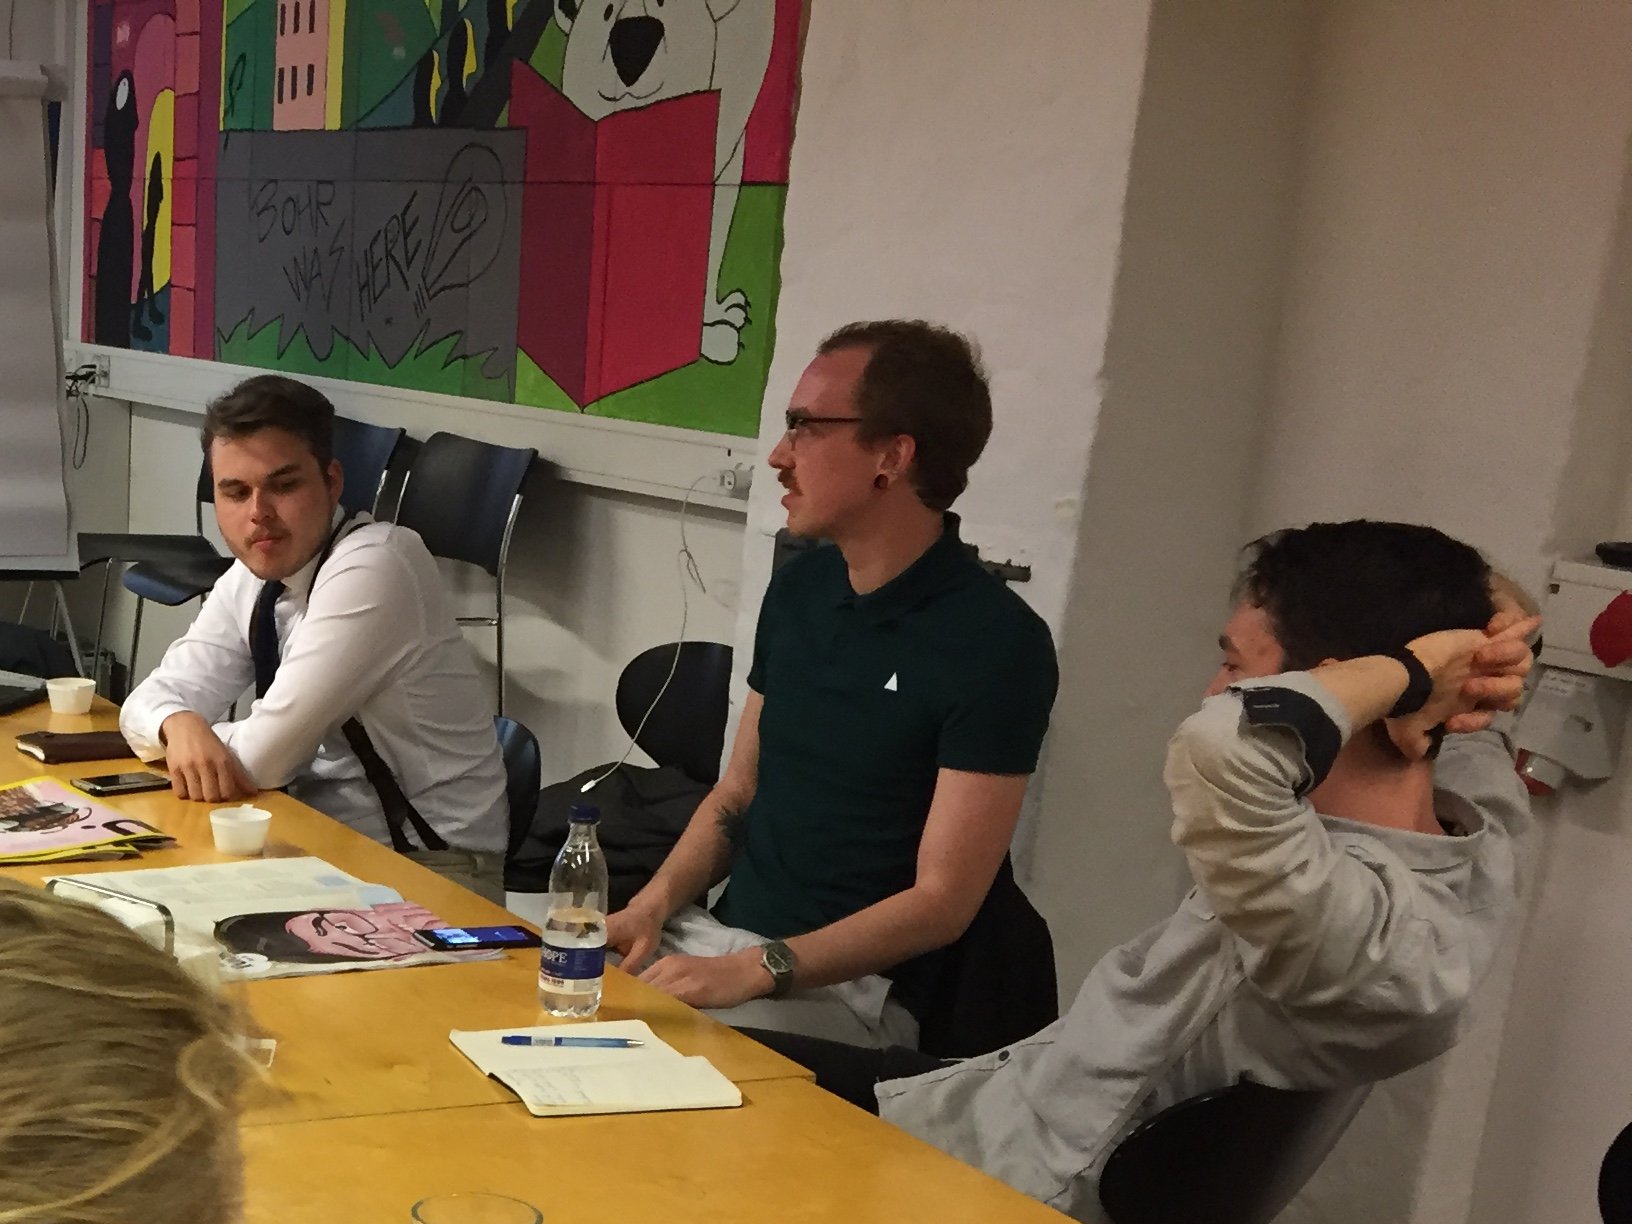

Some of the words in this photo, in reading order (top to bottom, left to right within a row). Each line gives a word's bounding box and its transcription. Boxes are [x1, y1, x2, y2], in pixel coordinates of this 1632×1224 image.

[252, 178, 336, 243] BOHR
[283, 218, 346, 311] WAS
[355, 190, 421, 322] HERE
